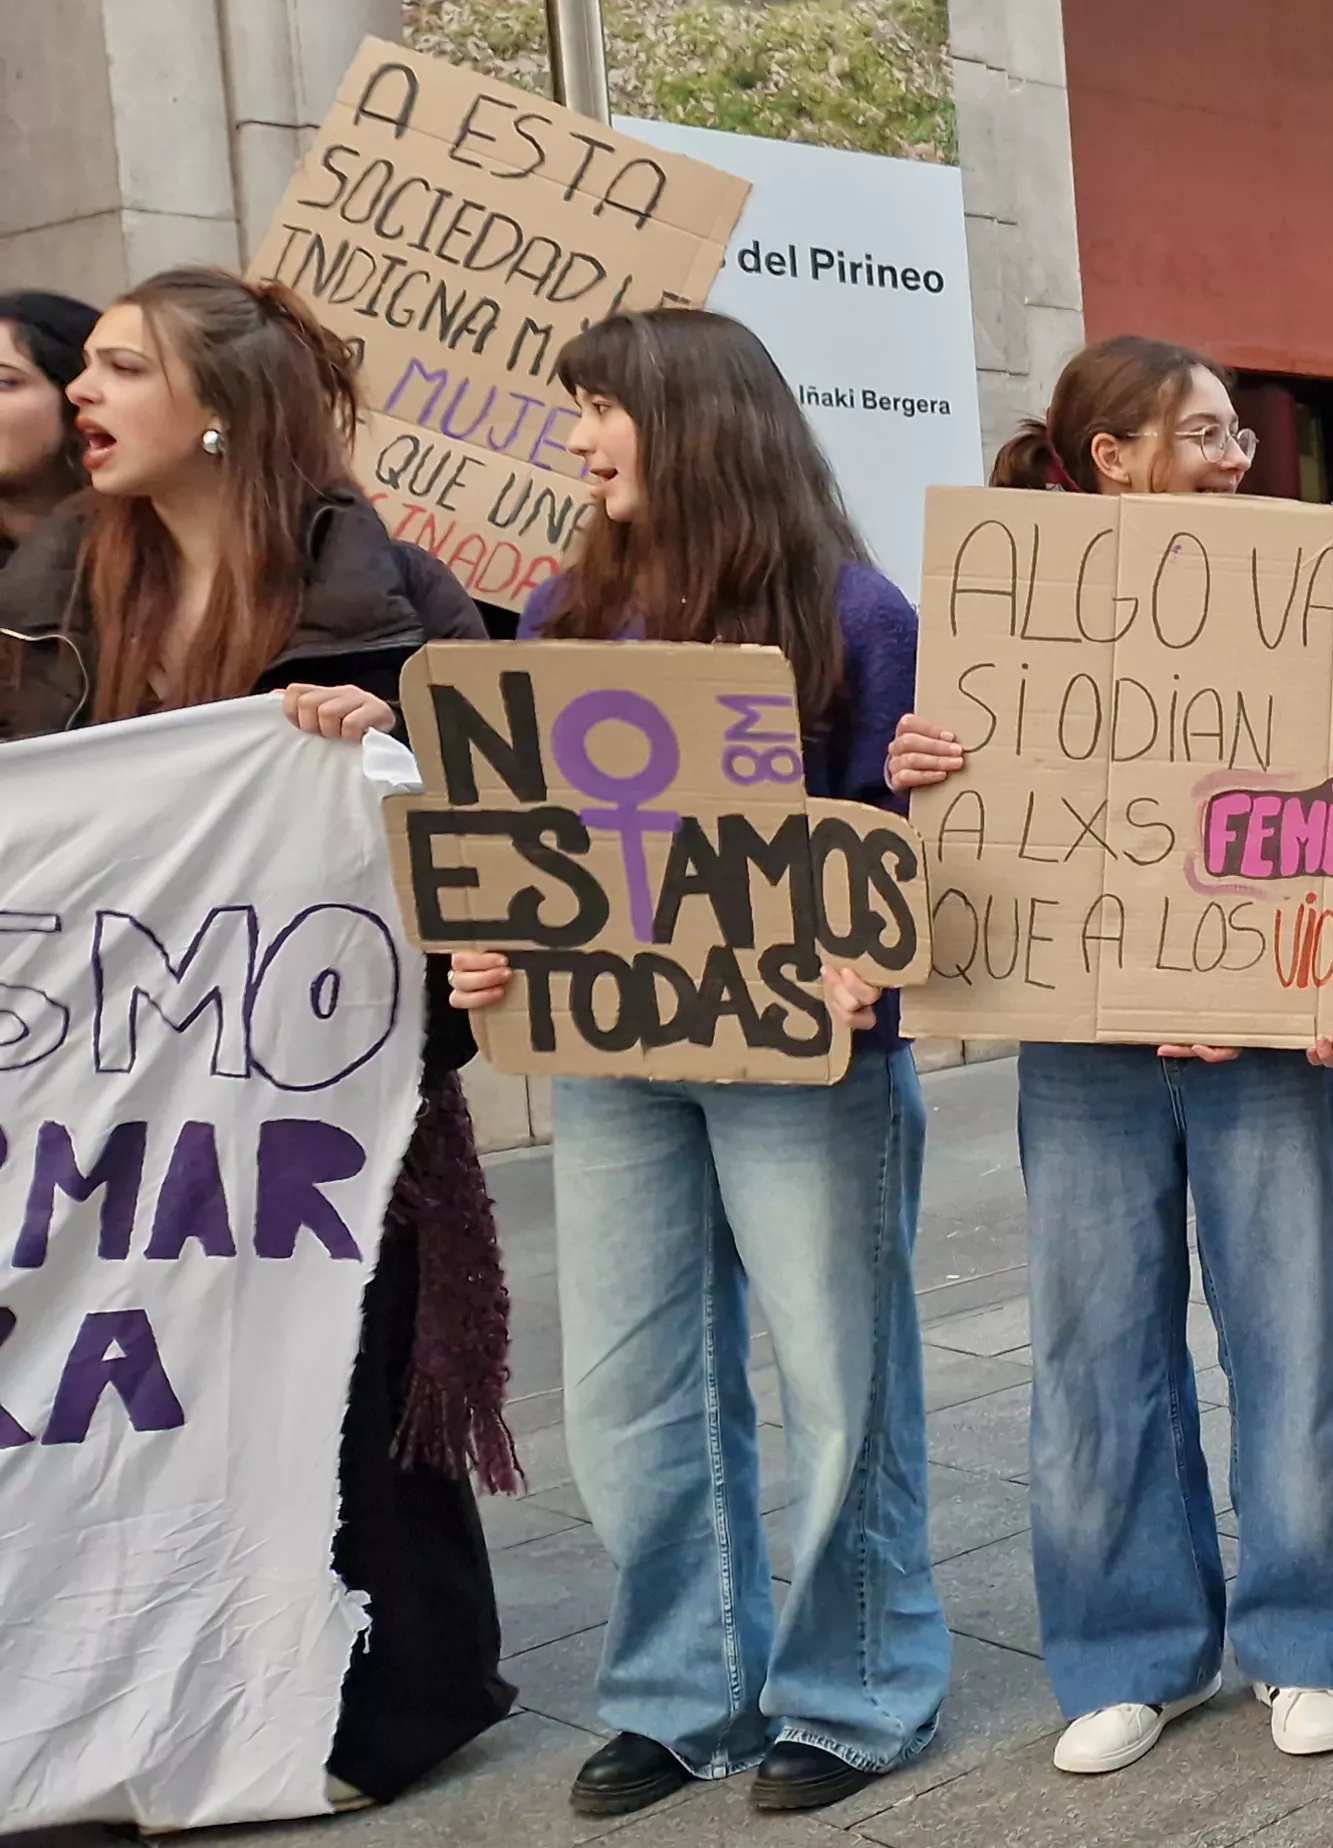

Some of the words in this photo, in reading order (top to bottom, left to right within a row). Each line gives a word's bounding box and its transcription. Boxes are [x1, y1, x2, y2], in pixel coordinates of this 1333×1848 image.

[353, 62, 419, 139] A
[449, 94, 667, 230] ESTA
[298, 144, 607, 302] SOCIEDAD
[738, 240, 799, 277] del
[810, 246, 945, 294] Pirineo
[259, 224, 500, 355] INDIGNA
[383, 357, 589, 478] MUJE
[799, 384, 856, 409] Iñaki
[862, 389, 951, 418] Bergera
[376, 434, 486, 511] QUE
[370, 492, 560, 600] INADA
[949, 519, 1212, 650] ALGO
[428, 671, 681, 805] NO
[716, 694, 804, 786] 8M
[937, 789, 985, 863] A
[1018, 790, 1176, 866] LXS
[406, 805, 919, 971] ESTAMOS
[932, 887, 1060, 990] QUE
[1081, 893, 1126, 974] A
[1156, 895, 1267, 973] LOS
[506, 944, 832, 1058] TODAS
[0, 1119, 367, 1268] MAR
